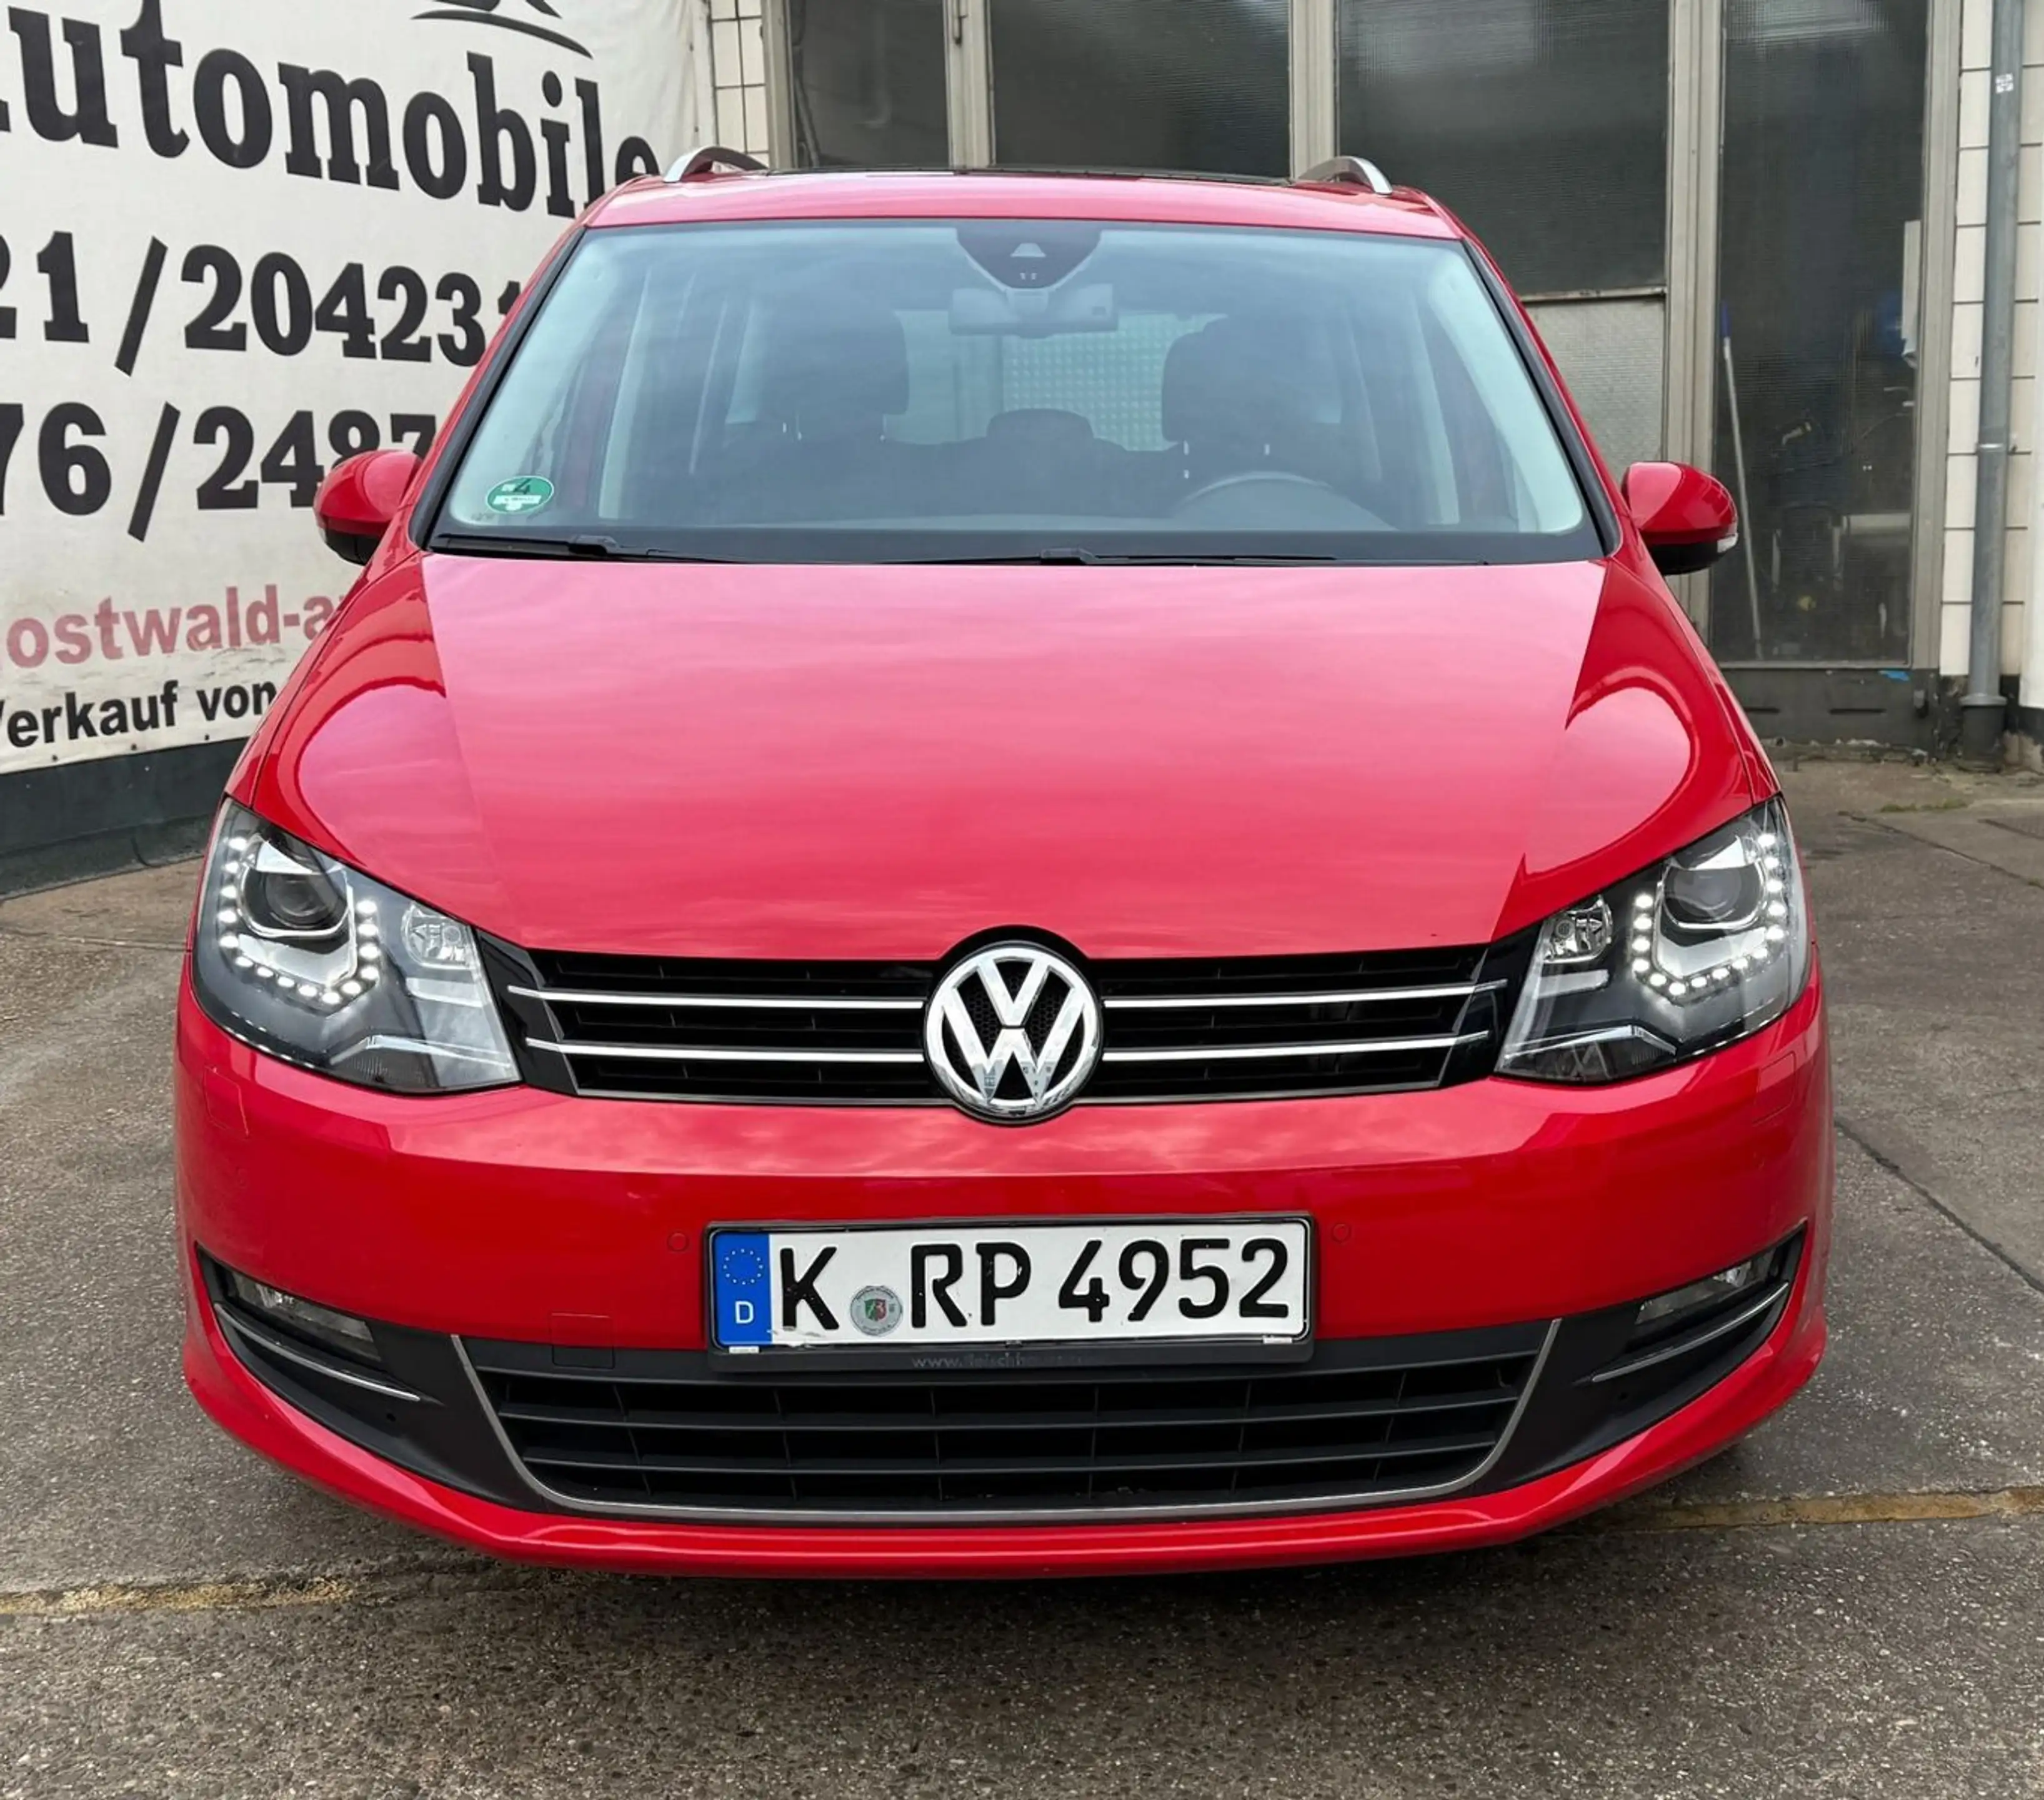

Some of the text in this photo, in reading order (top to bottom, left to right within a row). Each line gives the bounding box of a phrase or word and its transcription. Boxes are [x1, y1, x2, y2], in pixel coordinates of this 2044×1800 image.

[0, 0, 660, 218] utomobile
[0, 231, 521, 377] 1/20423
[6, 584, 346, 668] ostwald-a
[0, 680, 277, 748] erkauf von
[932, 948, 1096, 1110] VW
[734, 1300, 755, 1324] D
[779, 1238, 1289, 1331] K RP 4952
